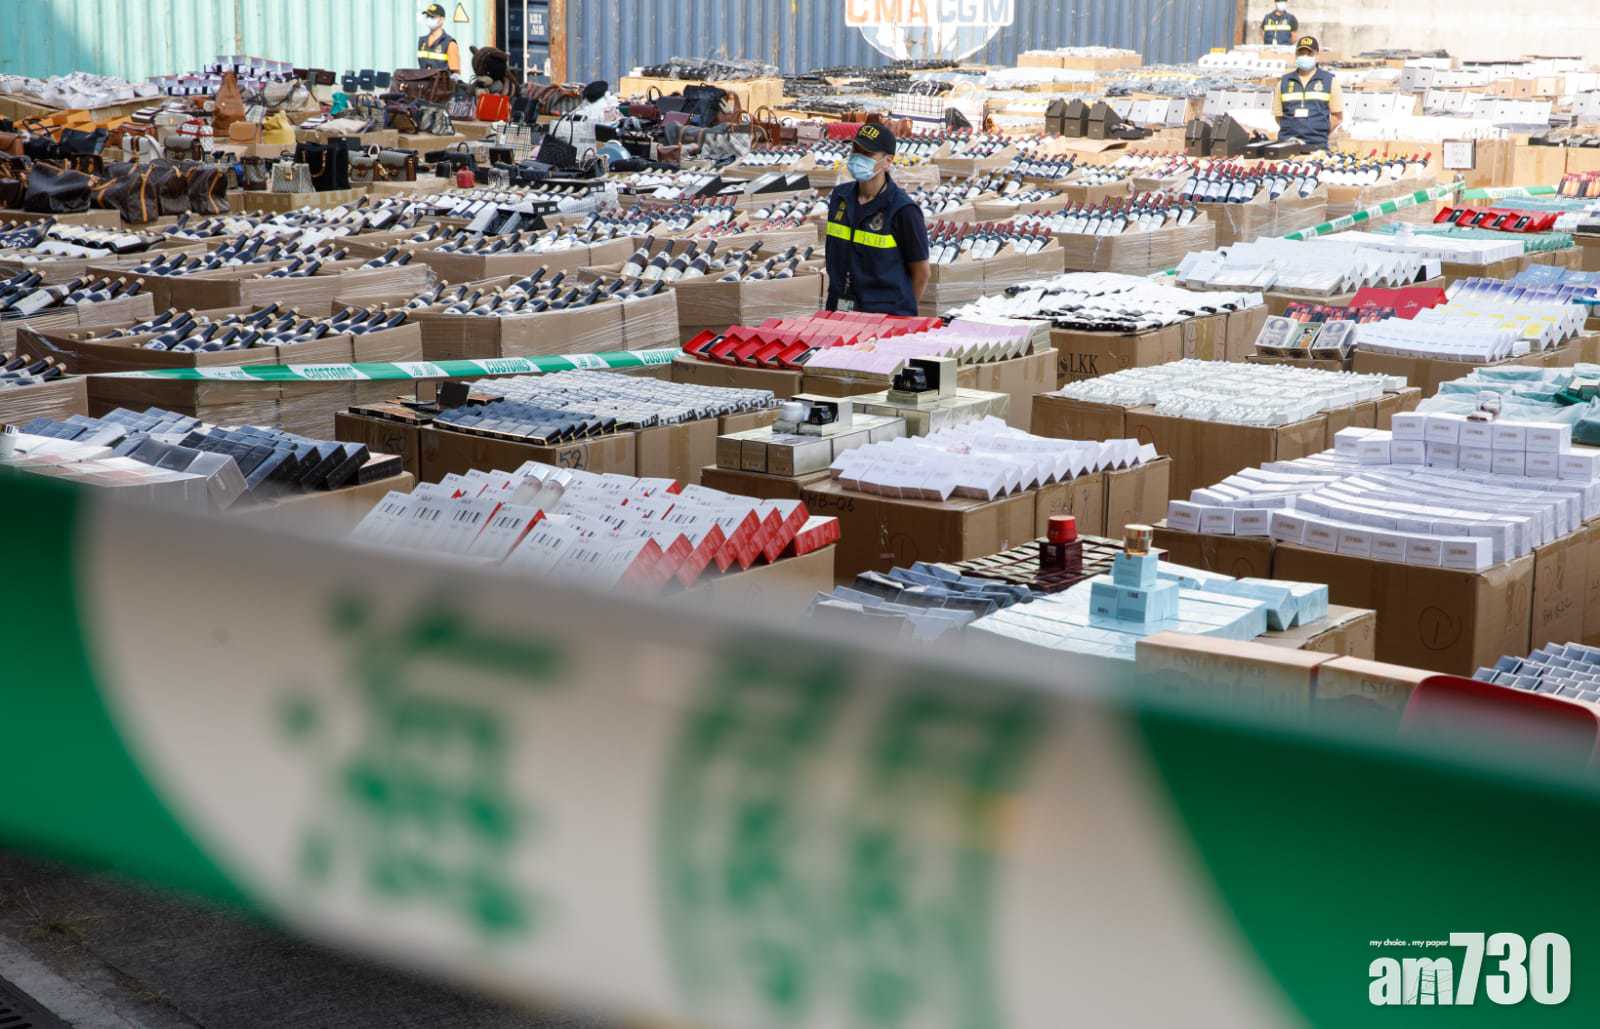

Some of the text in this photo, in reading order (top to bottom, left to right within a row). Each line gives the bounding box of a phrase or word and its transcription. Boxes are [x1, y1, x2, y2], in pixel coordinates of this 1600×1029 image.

[847, 0, 1010, 24] CMA CGM
[303, 367, 358, 379] CUSTOMS
[485, 359, 531, 373] CUSTOMS
